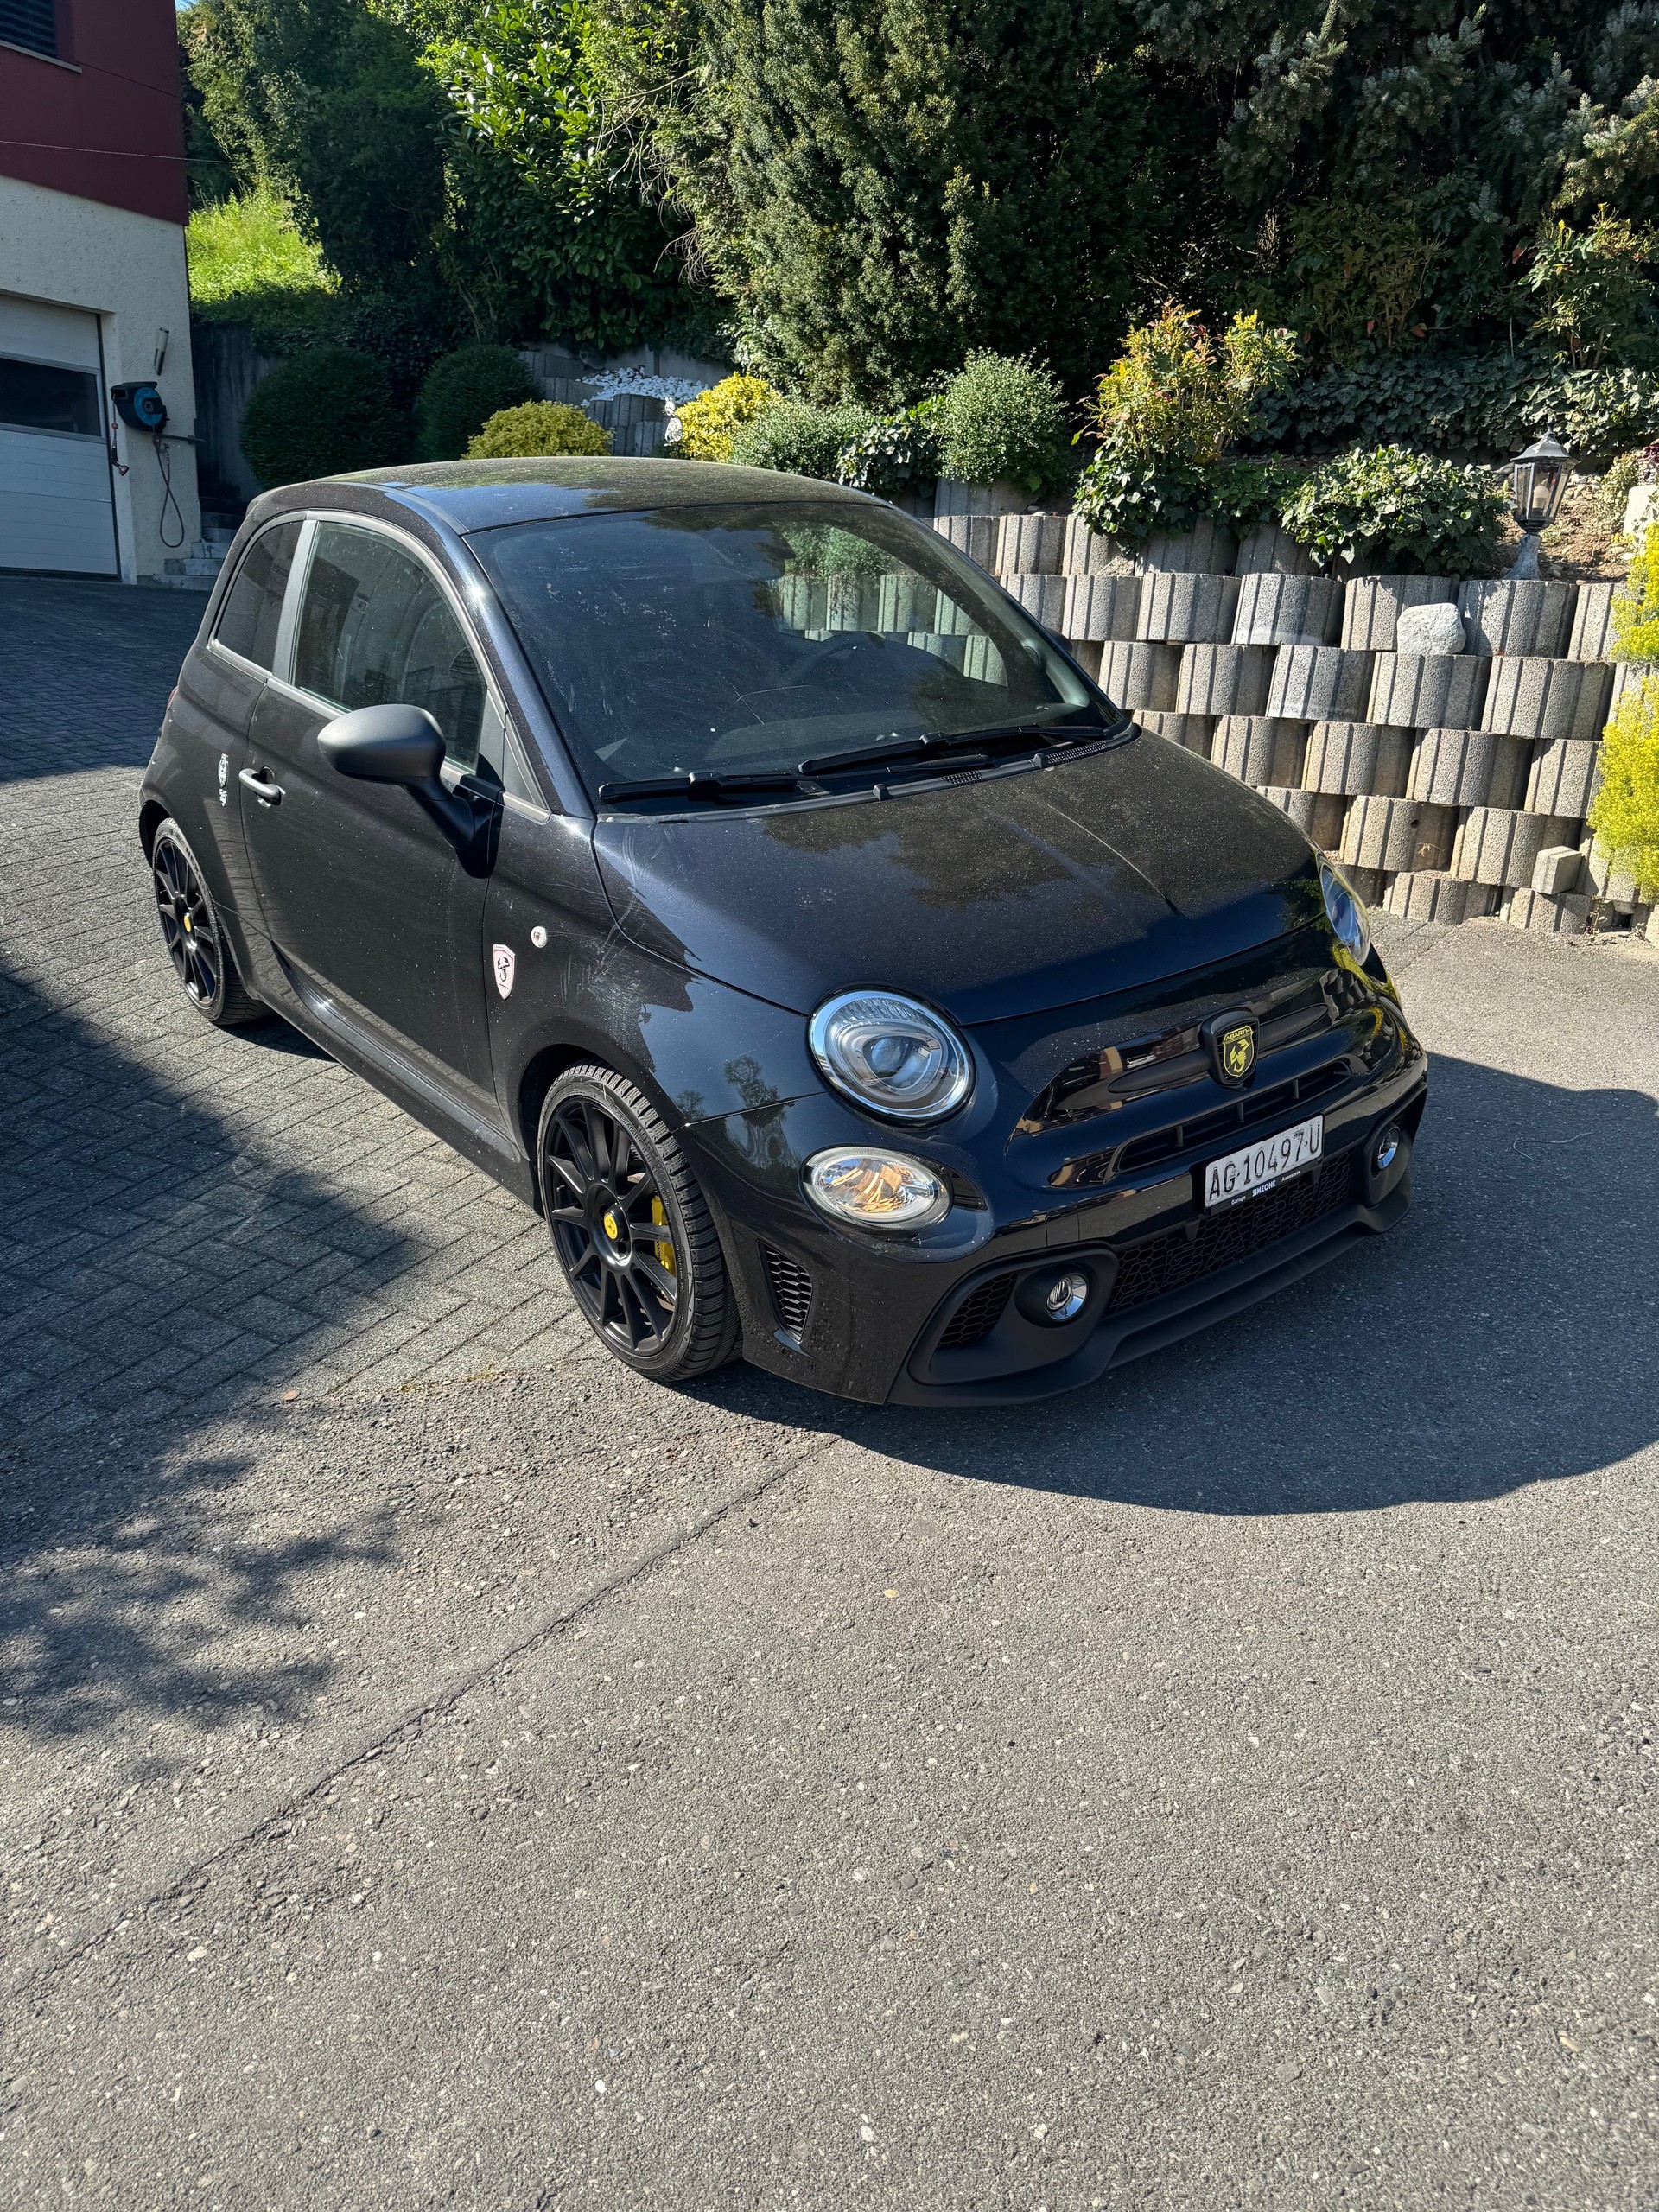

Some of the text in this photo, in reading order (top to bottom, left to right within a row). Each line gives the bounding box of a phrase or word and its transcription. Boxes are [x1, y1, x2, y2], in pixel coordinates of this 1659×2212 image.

[1225, 1028, 1250, 1040] ABARTH
[1230, 1196, 1246, 1205] Garage
[1251, 1179, 1276, 1198] SIMEONE
